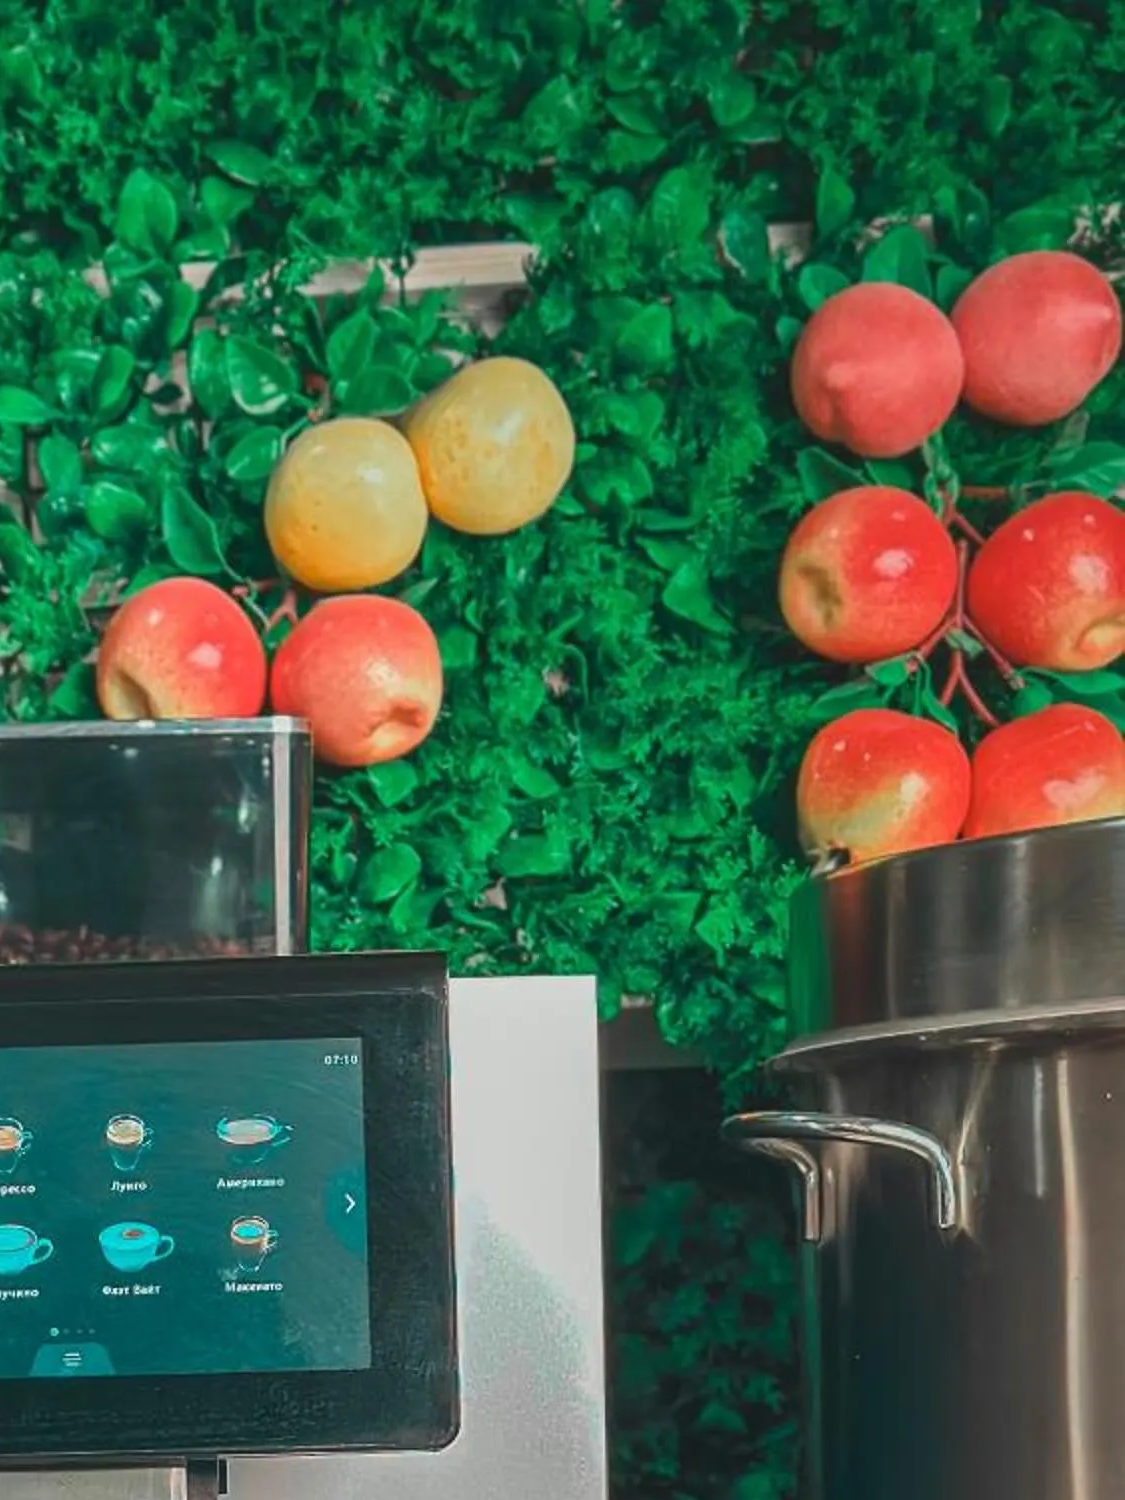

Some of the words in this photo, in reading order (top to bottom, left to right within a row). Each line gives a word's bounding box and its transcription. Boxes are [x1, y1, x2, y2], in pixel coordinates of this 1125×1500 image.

[324, 1054, 358, 1065] 07:10
[110, 1180, 148, 1193] Лунго
[216, 1177, 286, 1190] Американо
